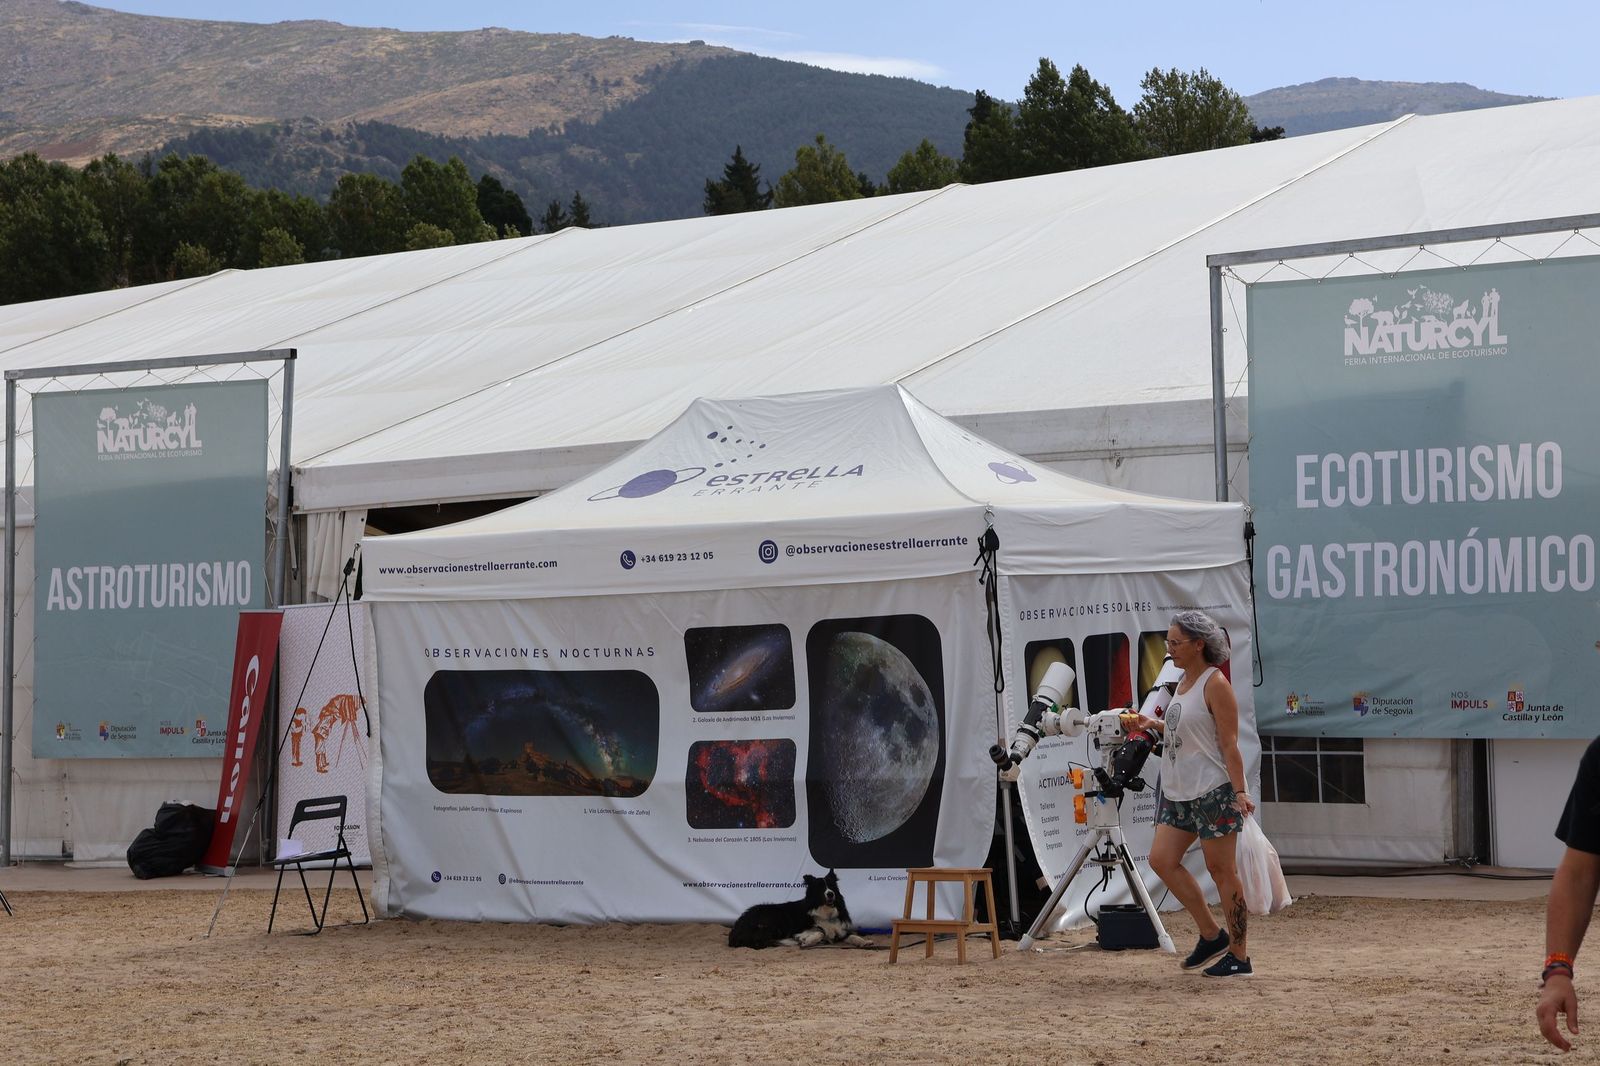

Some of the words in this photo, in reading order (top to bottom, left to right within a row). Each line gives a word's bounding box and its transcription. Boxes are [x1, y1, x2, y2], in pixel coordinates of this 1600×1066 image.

[1344, 318, 1508, 356] NATURCYL
[1344, 357, 1367, 366] FERIA
[1369, 353, 1436, 365] INTERNACIONAL
[1438, 351, 1450, 360] DE
[1452, 347, 1508, 359] ECOTURISMO
[97, 424, 202, 453] NATURCYL
[1296, 441, 1563, 509] ECOTURISMO
[692, 480, 823, 497] ERRANTE
[785, 535, 968, 557] @observacionesestrellaerrante
[641, 554, 656, 563] +34
[658, 553, 674, 562] 619
[677, 552, 687, 562] 23
[690, 551, 700, 560] 12
[703, 551, 714, 560] 05
[1266, 527, 1596, 600] GASTRONÓMICO
[379, 559, 558, 575] www.observacionestrellaerrante.com
[47, 560, 251, 611] ASTROTURISMO
[424, 647, 549, 658] OBSERVACIONES
[560, 646, 655, 659] NOCTURNAS
[1372, 697, 1413, 706] Diputación
[1451, 691, 1469, 699] NOS
[1372, 707, 1381, 715] de
[1384, 707, 1413, 717] Segovia
[1526, 704, 1550, 712] Junta
[1552, 704, 1564, 712] de
[1502, 713, 1532, 721] Castilla
[1534, 715, 1540, 723] y
[1542, 713, 1564, 721] León
[220, 654, 260, 823] Canon
[1039, 775, 1074, 789] ACTIVIDA
